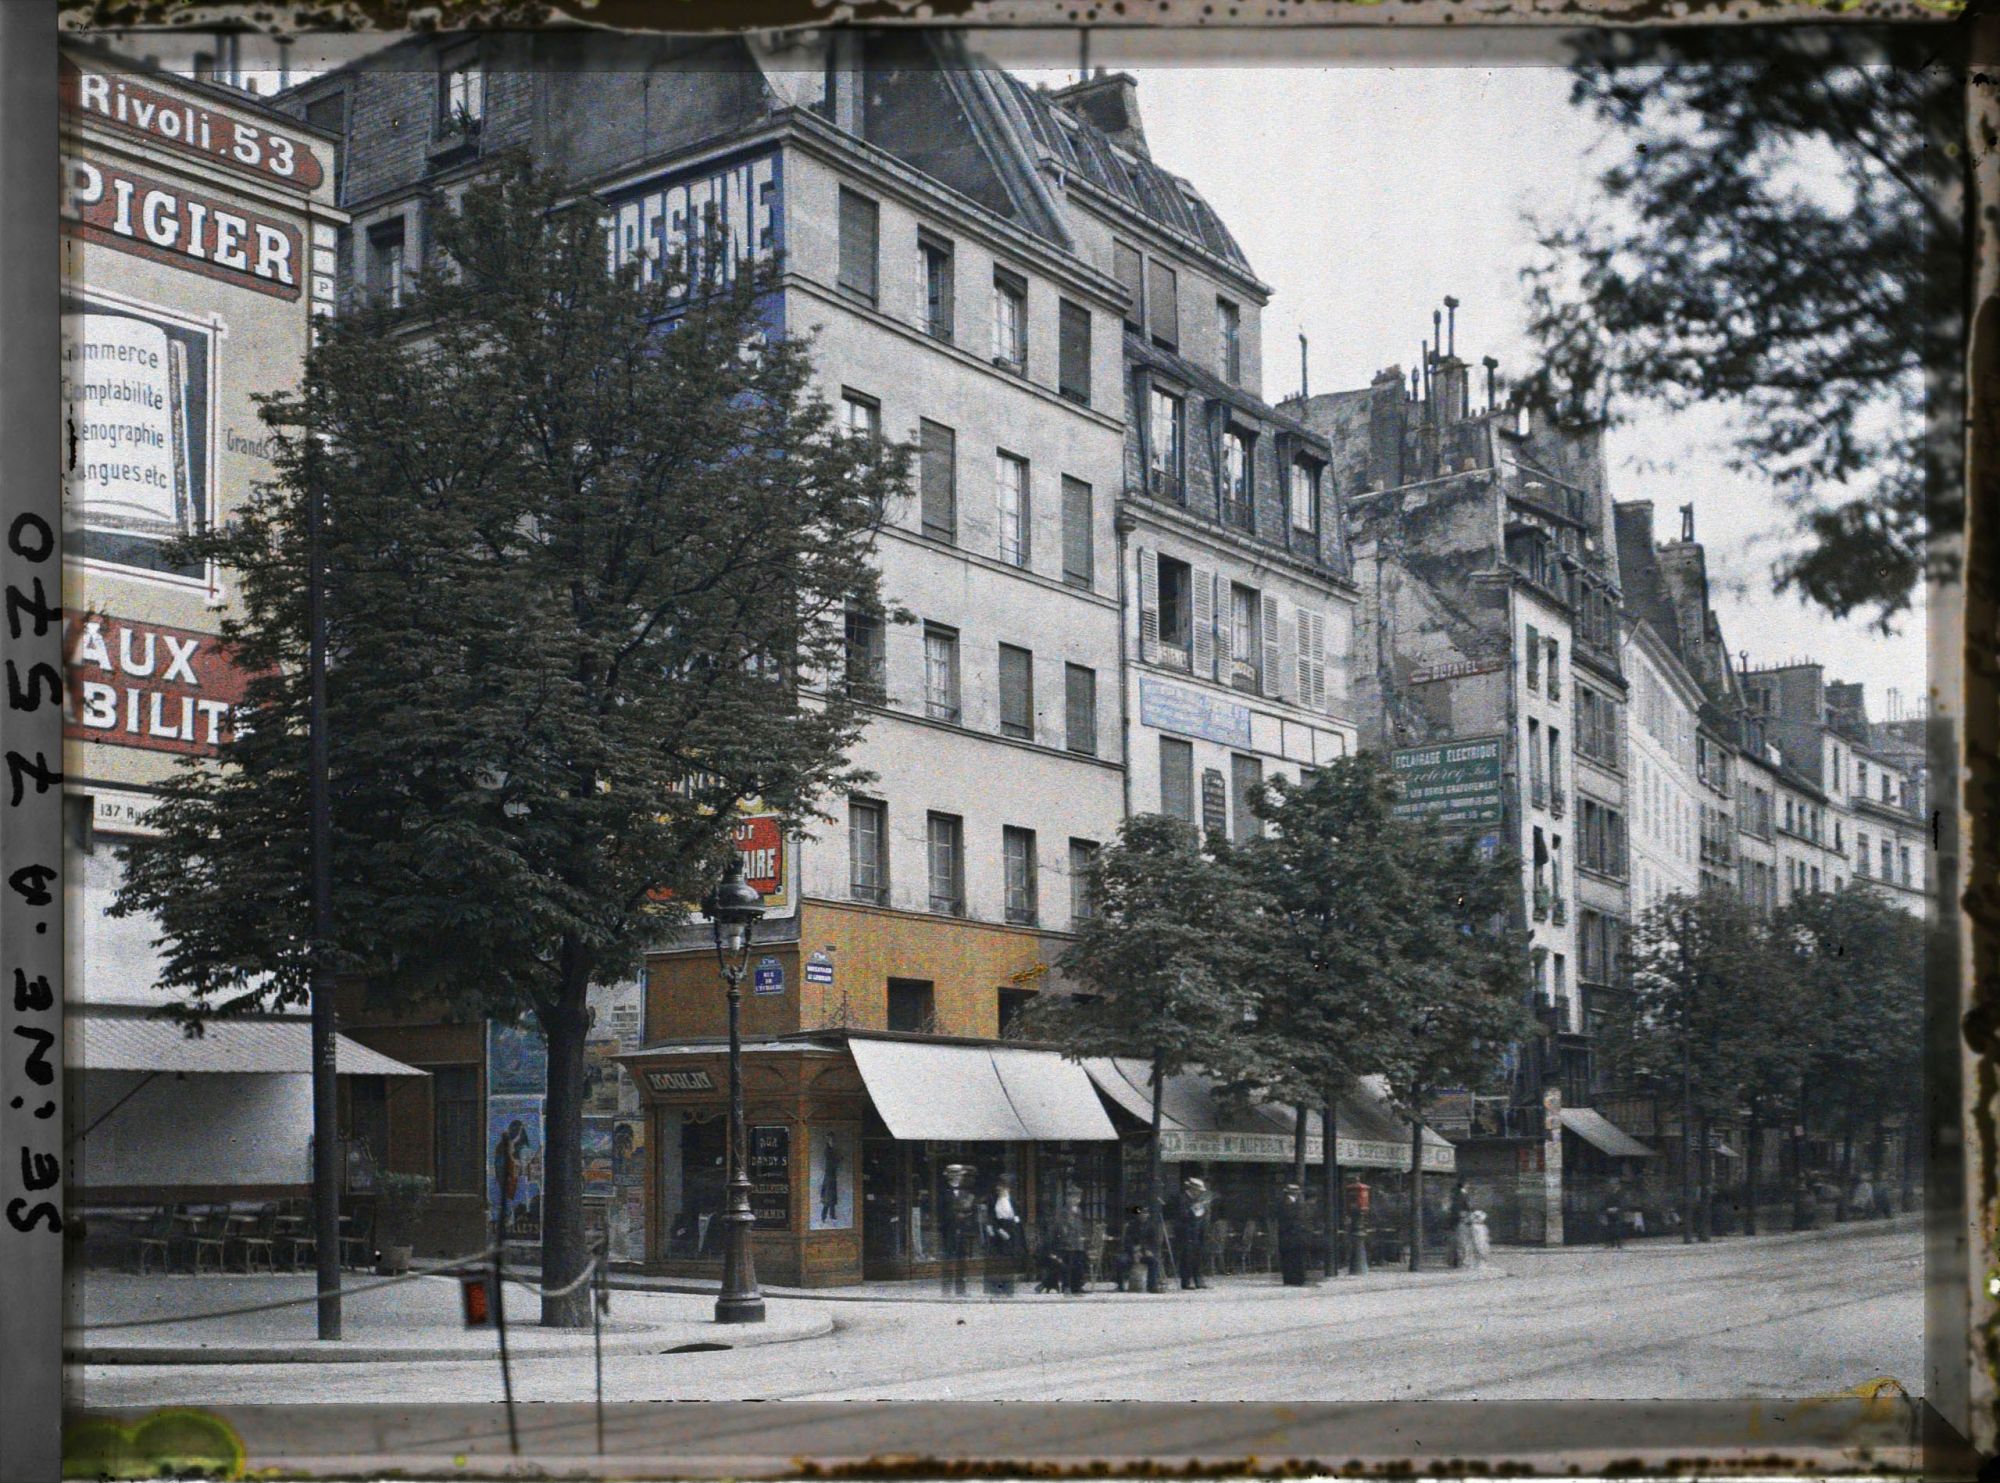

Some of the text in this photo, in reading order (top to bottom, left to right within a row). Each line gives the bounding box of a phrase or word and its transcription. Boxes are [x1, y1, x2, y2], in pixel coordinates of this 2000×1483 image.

[62, 158, 294, 285] PIGIER
[70, 622, 200, 684] AUX
[82, 680, 256, 745] BILIT
[100, 803, 121, 817] 137
